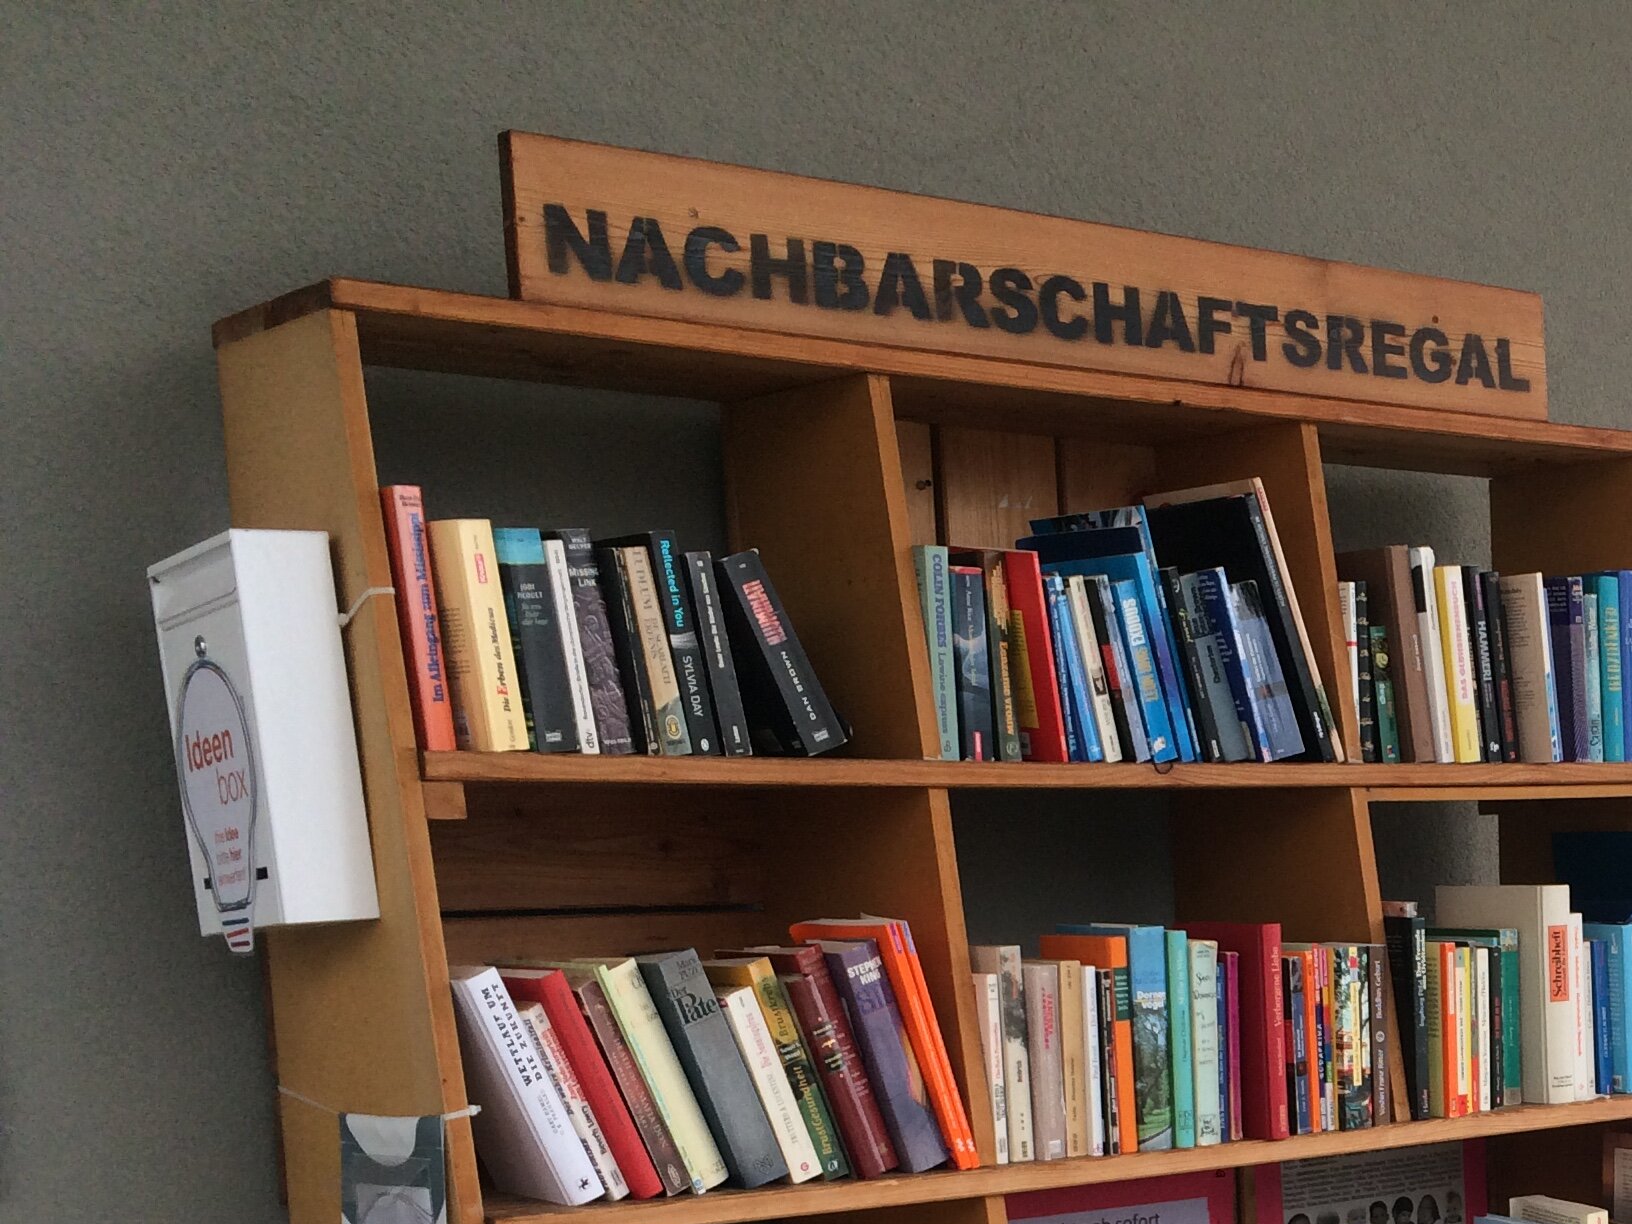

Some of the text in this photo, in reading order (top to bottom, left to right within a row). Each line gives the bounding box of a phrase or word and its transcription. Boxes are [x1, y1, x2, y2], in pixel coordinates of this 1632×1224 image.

[542, 202, 1531, 392] NACHBARSCHAFTSREGAL
[659, 540, 684, 628] Reflected in You
[931, 553, 944, 599] COLIN
[934, 599, 948, 648] FORBES
[1122, 598, 1145, 645] EXODUS
[682, 655, 704, 718] SYLVIA DAY
[780, 651, 817, 721] DAN BROWN
[185, 729, 234, 773] Ideen
[216, 768, 249, 806] box
[1551, 929, 1563, 999] Schreibheft
[480, 987, 533, 1088] WETTLAUF UM
[490, 983, 543, 1082] DIE ZUKUNFT
[672, 990, 718, 1025] Pate
[761, 975, 788, 1037] Brustkrebs
[792, 1064, 833, 1156] BrustGesundheit
